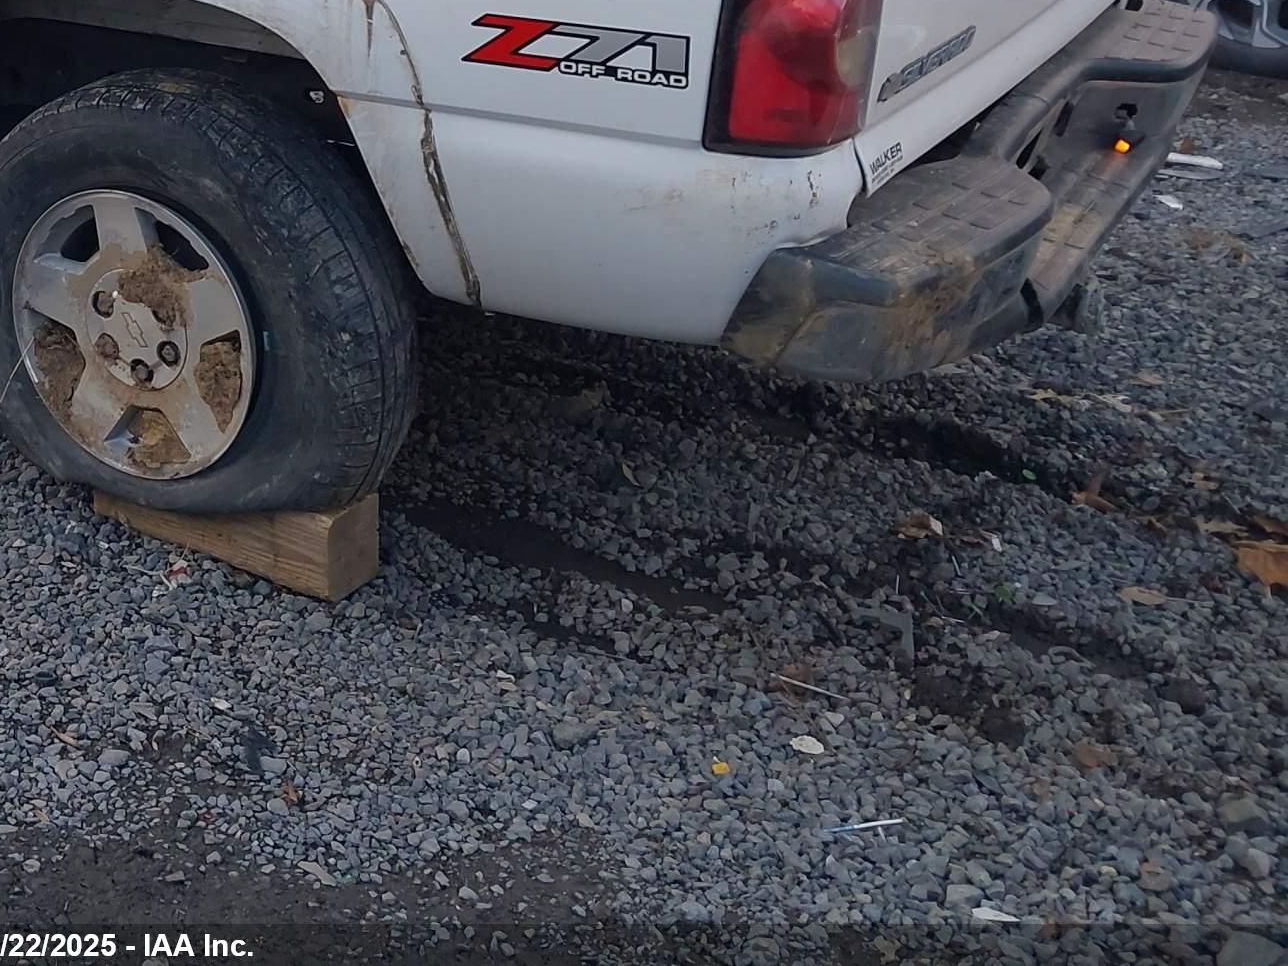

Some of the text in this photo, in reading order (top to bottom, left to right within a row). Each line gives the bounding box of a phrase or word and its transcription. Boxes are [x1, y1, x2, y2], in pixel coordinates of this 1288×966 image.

[461, 13, 691, 74] Z71
[559, 61, 688, 88] OFF ROAD
[869, 141, 902, 175] WALKER
